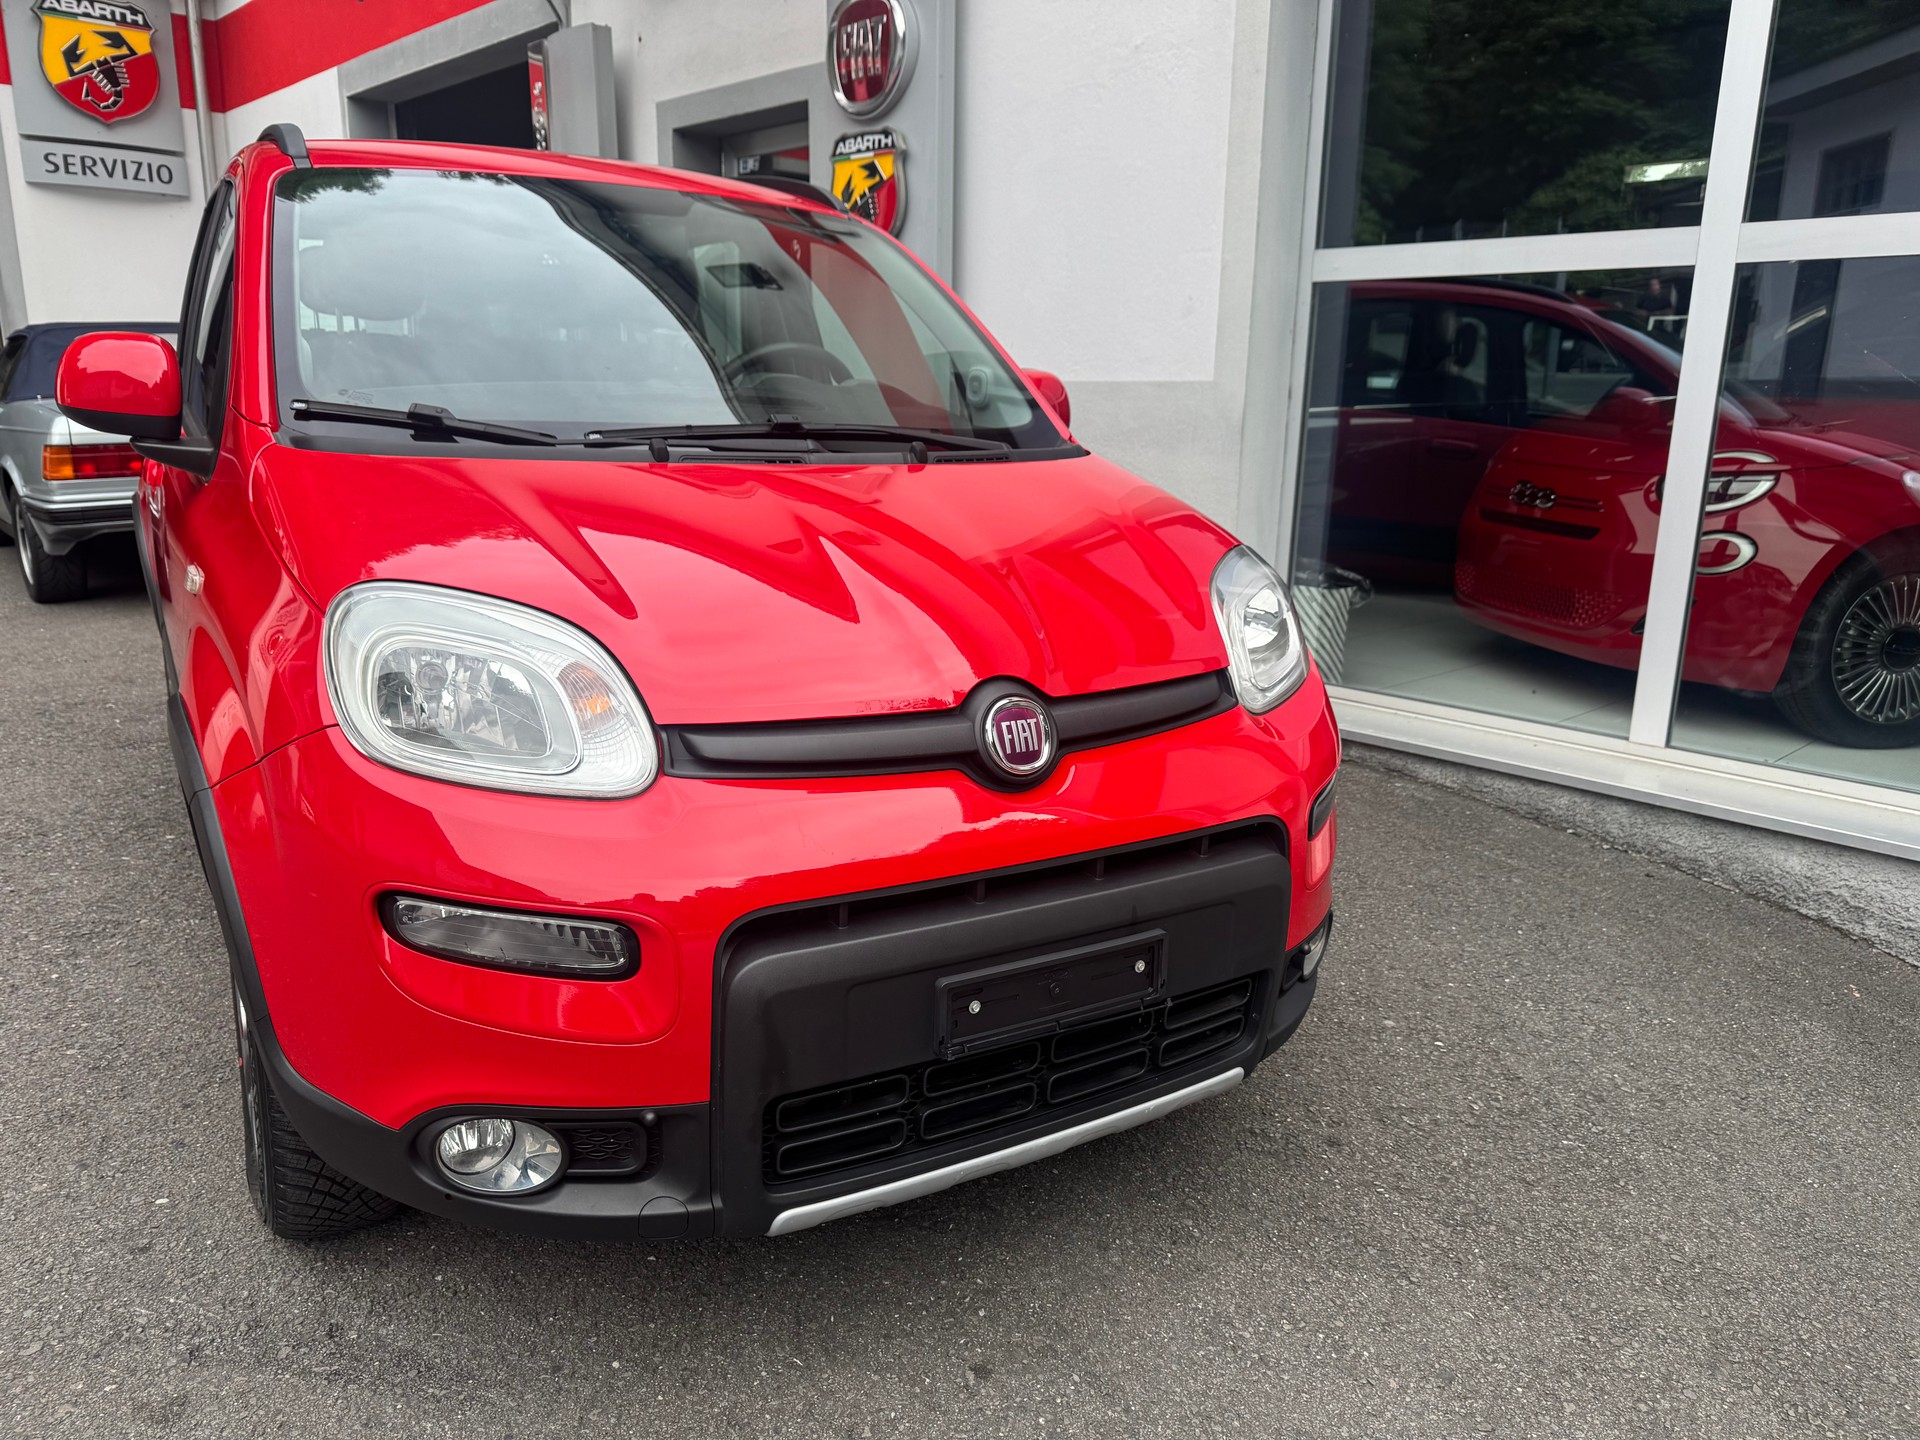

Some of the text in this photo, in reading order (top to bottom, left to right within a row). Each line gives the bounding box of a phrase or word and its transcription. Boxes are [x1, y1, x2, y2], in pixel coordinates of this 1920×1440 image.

[43, 0, 143, 25] ABARTH
[841, 14, 887, 84] FIAT
[835, 134, 892, 155] ABARTH
[43, 152, 173, 185] SERVIZIO
[1001, 718, 1039, 754] FIAT
